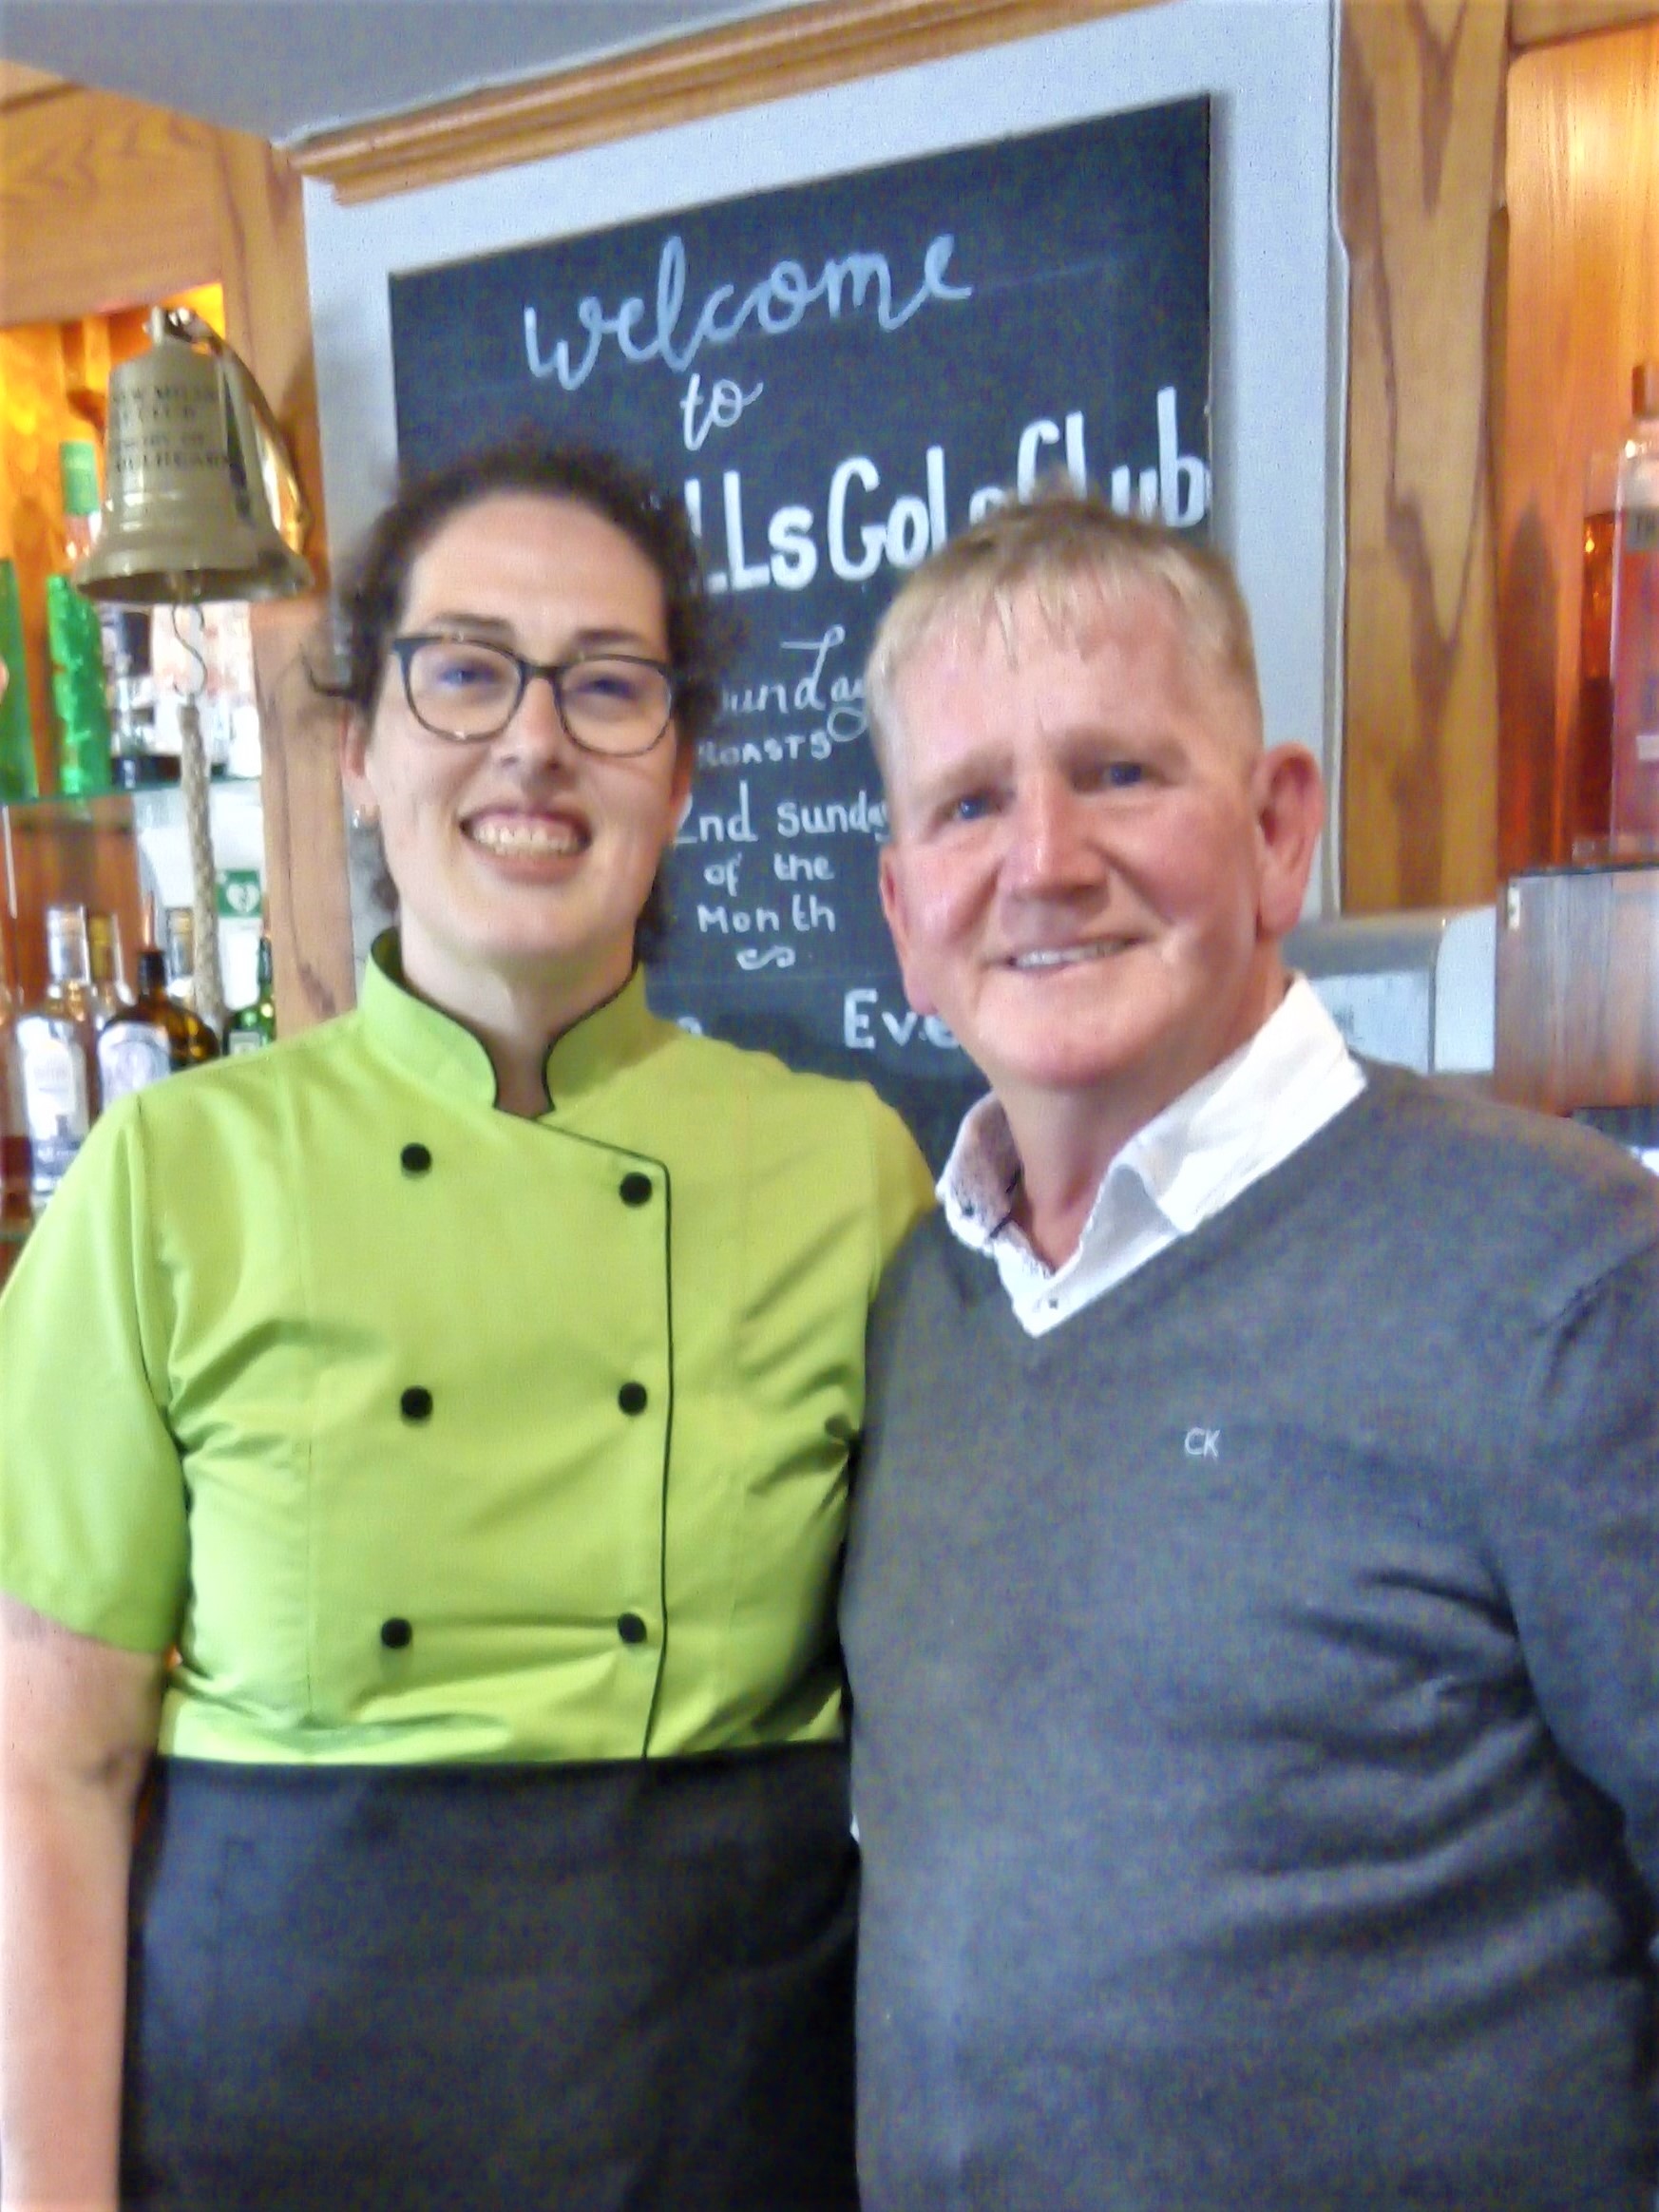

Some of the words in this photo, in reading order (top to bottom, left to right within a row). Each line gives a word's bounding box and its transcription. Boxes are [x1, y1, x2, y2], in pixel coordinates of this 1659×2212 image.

[679, 372, 763, 451] to
[703, 851, 743, 898] of
[773, 852, 835, 882] the
[696, 893, 836, 934] Month
[1184, 1426, 1221, 1458] CK
